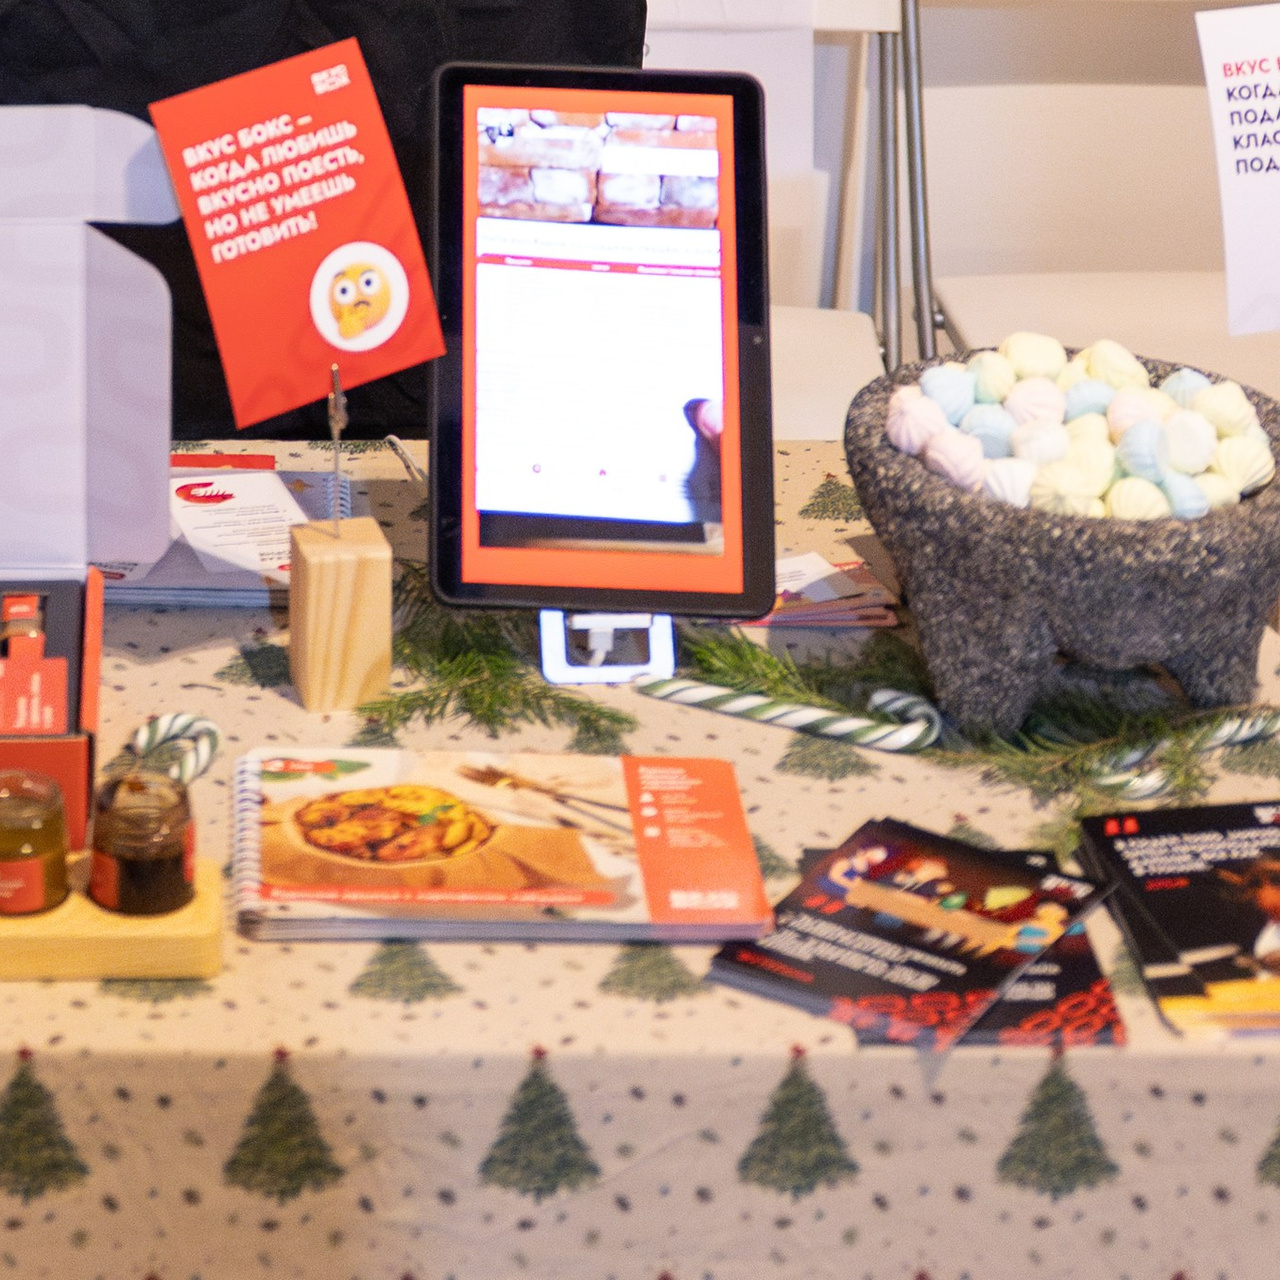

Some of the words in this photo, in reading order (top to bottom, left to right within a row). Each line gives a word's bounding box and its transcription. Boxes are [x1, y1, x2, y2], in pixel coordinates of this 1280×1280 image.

[1223, 59, 1271, 77] ВКУС
[1227, 84, 1280, 101] КОГД
[182, 134, 236, 168] ВКУС
[237, 114, 294, 149] БОКС
[190, 153, 260, 191] КОГДА
[261, 120, 357, 167] ЛЮБИШЬ
[197, 172, 280, 215] ВКУСНО
[281, 146, 365, 186] ПОЕСТЬ,
[204, 213, 238, 240] НО
[240, 201, 270, 228] НЕ
[271, 173, 356, 215] УМЕЕШЬ
[211, 210, 318, 264] ГОТОВИТЬ!
